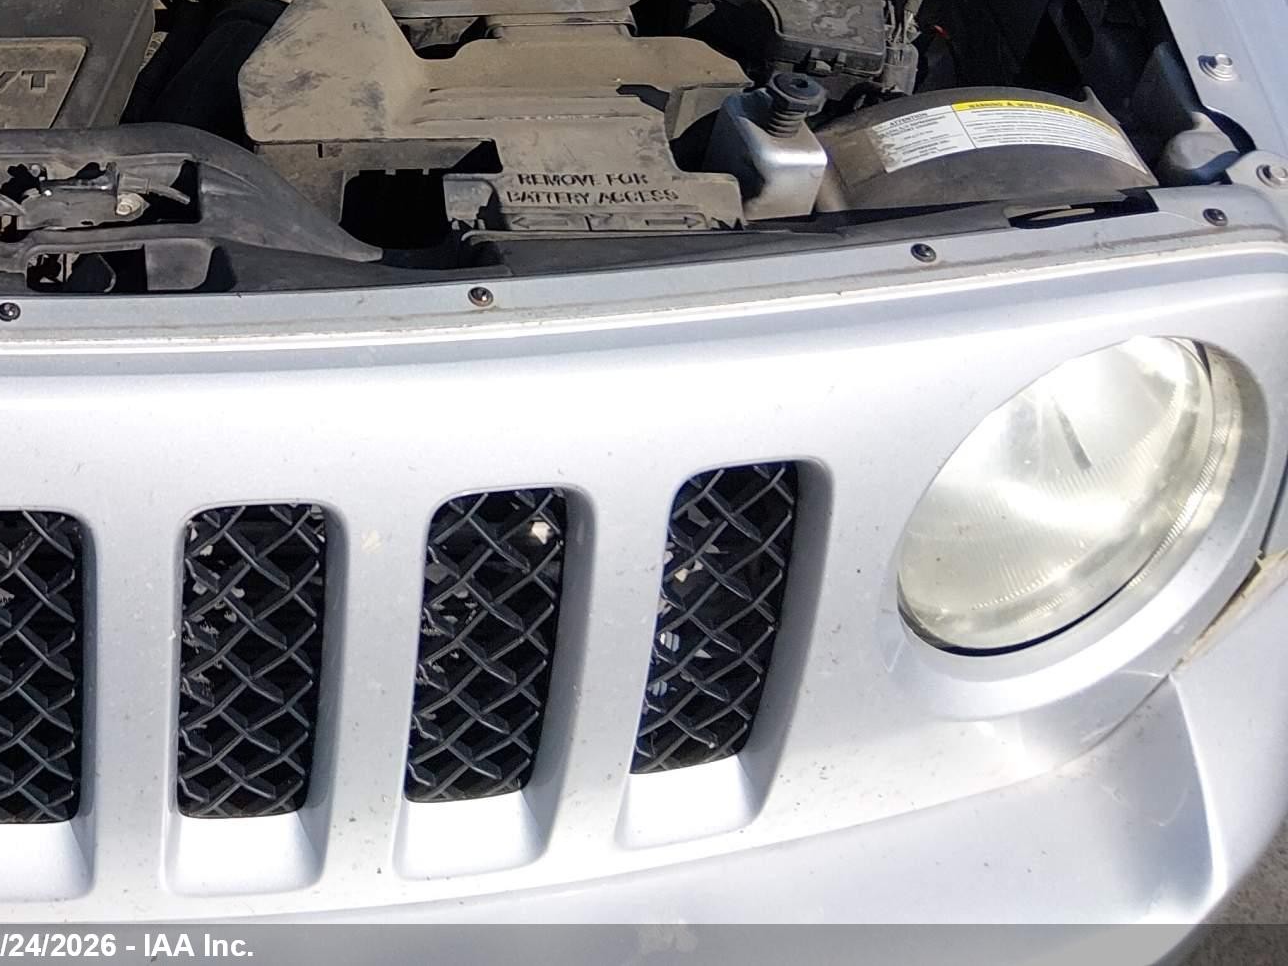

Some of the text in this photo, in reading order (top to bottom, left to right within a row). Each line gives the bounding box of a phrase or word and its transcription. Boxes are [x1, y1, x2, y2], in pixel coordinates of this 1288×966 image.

[517, 172, 648, 186] REMOVE FOR
[506, 188, 679, 204] BATTERY ACCESS
